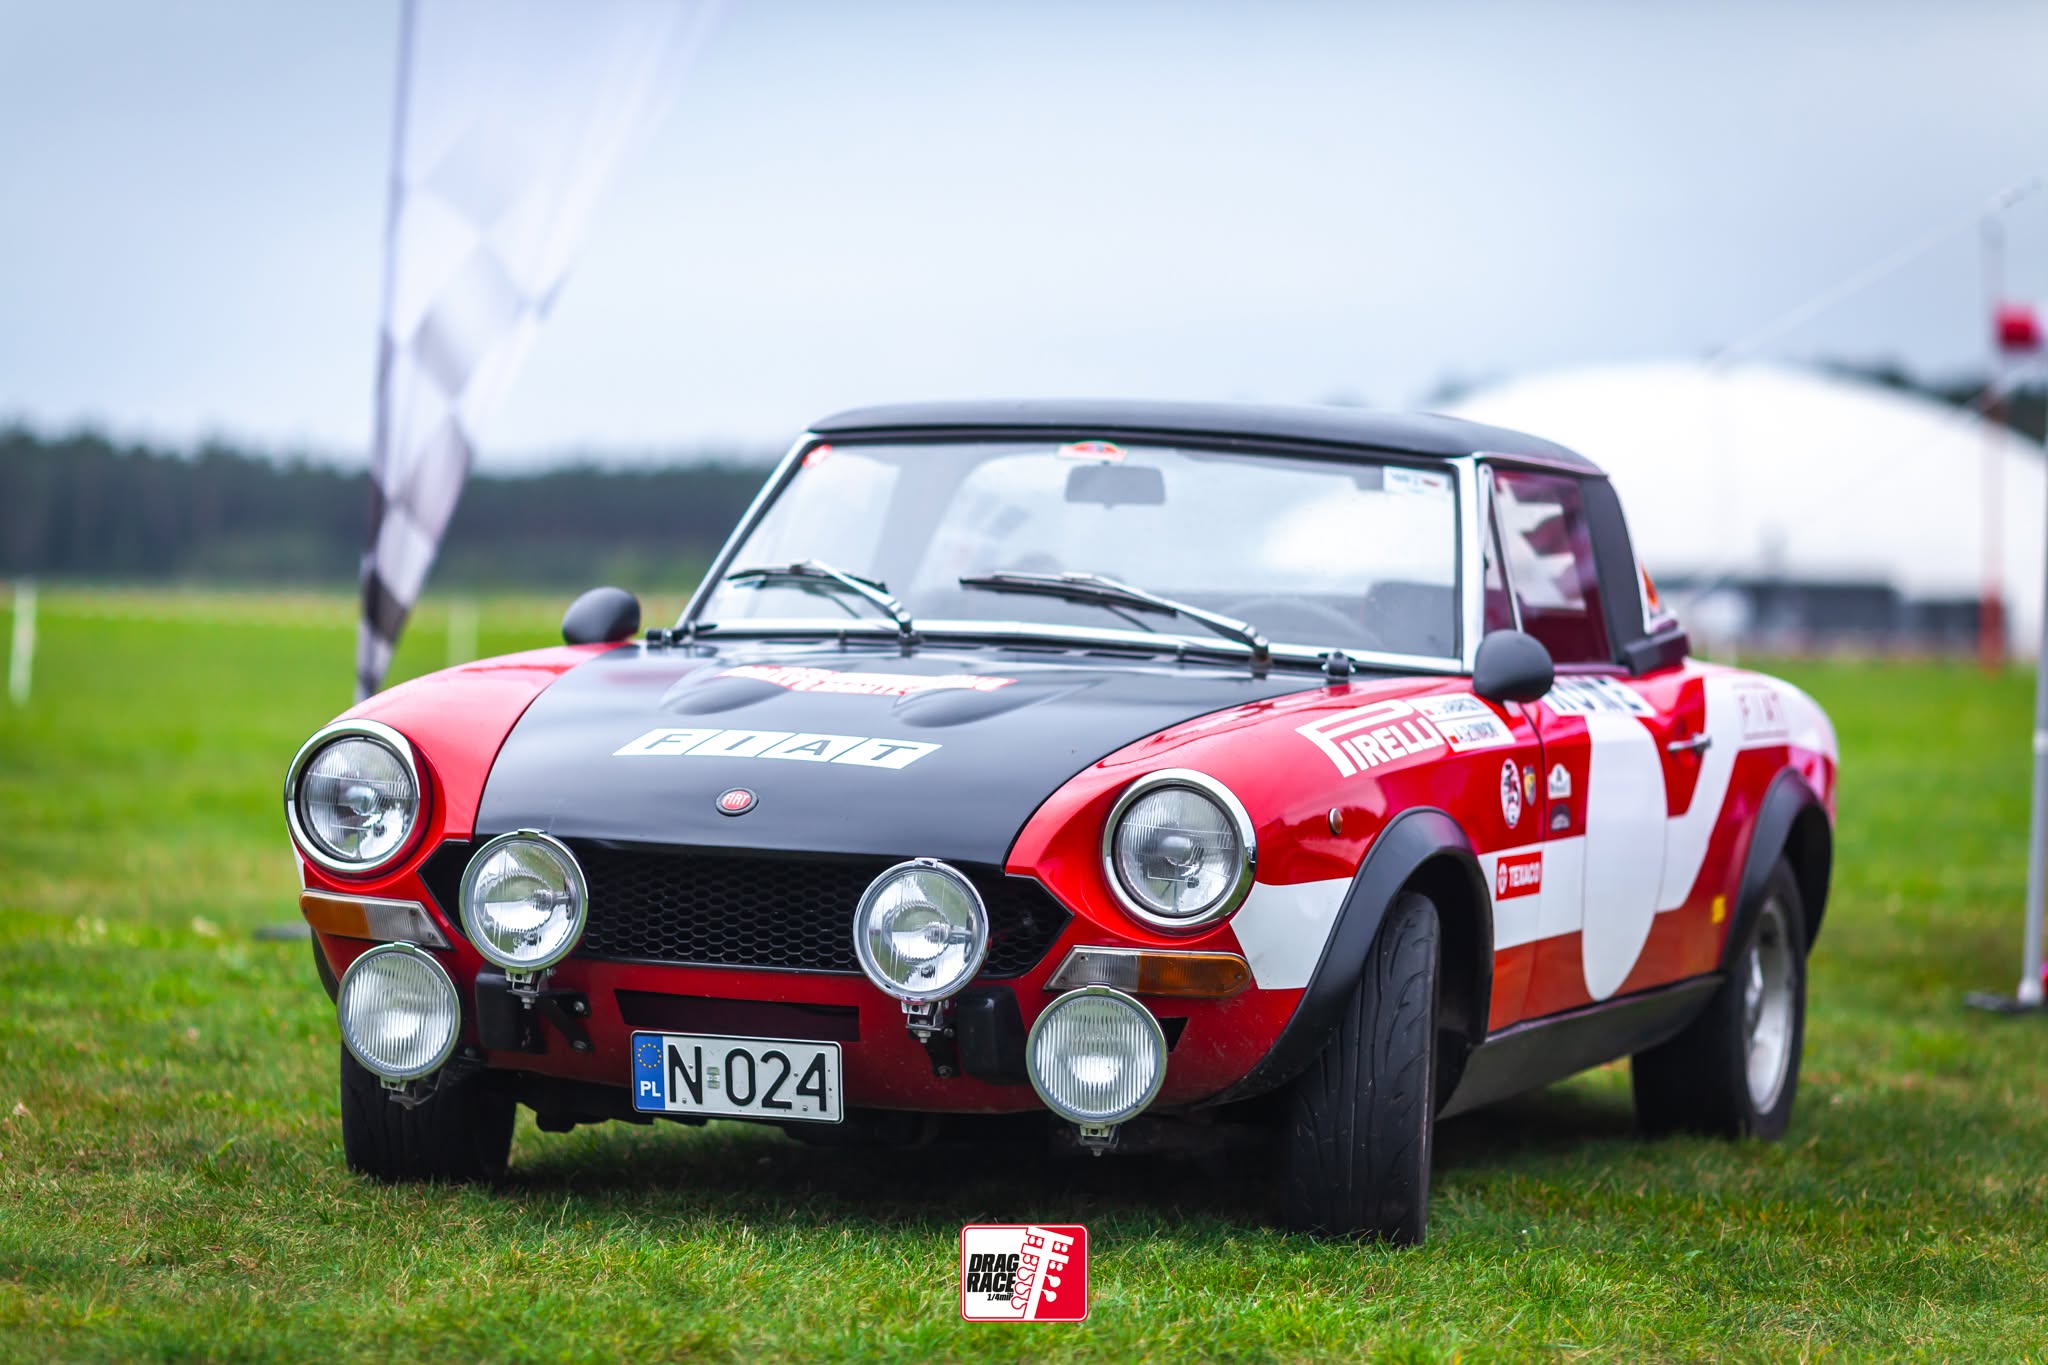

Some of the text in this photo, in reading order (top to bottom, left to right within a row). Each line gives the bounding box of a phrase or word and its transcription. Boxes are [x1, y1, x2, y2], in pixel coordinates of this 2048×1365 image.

[643, 732, 919, 762] FIAT
[1295, 699, 1445, 778] PIRELLI
[723, 792, 750, 807] FIAT
[1508, 861, 1541, 888] TEXACO
[640, 1080, 661, 1097] PL
